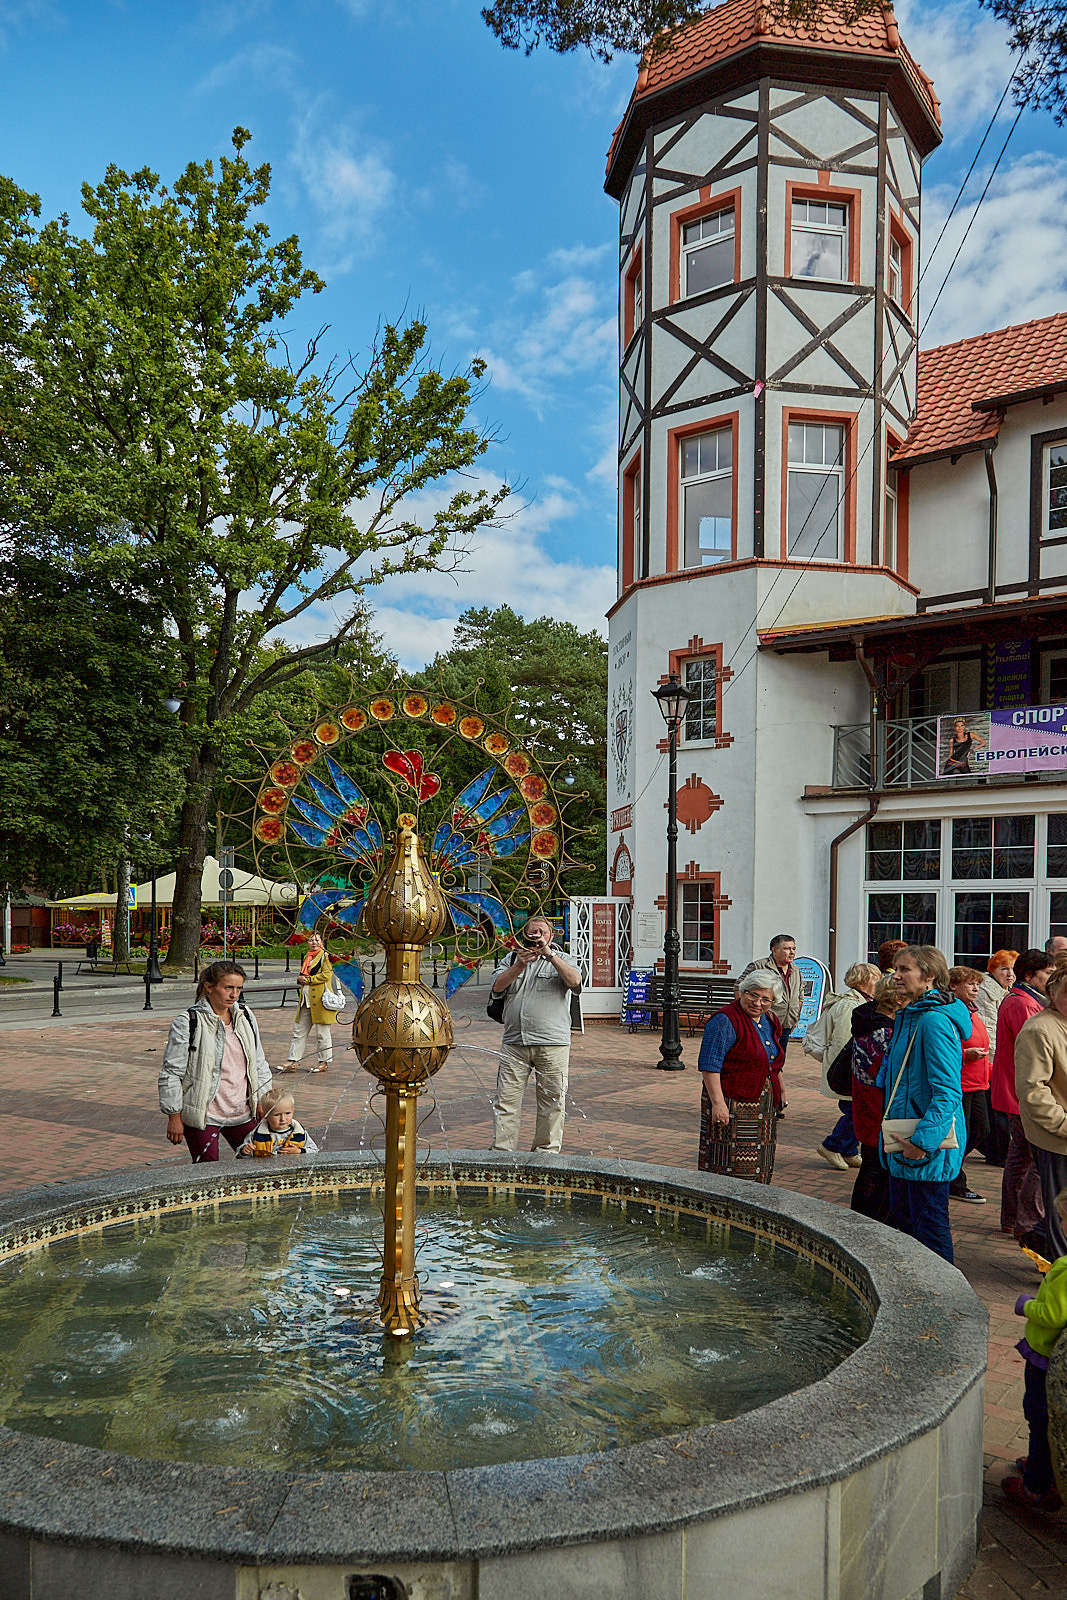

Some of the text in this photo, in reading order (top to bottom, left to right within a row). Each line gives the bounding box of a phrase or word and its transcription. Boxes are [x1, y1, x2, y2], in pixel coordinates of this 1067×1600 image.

[996, 652, 1030, 663] hummel
[997, 673, 1028, 683] одежда
[1004, 684, 1020, 692] для
[999, 693, 1025, 702] спорта
[1012, 707, 1067, 726] СПОР
